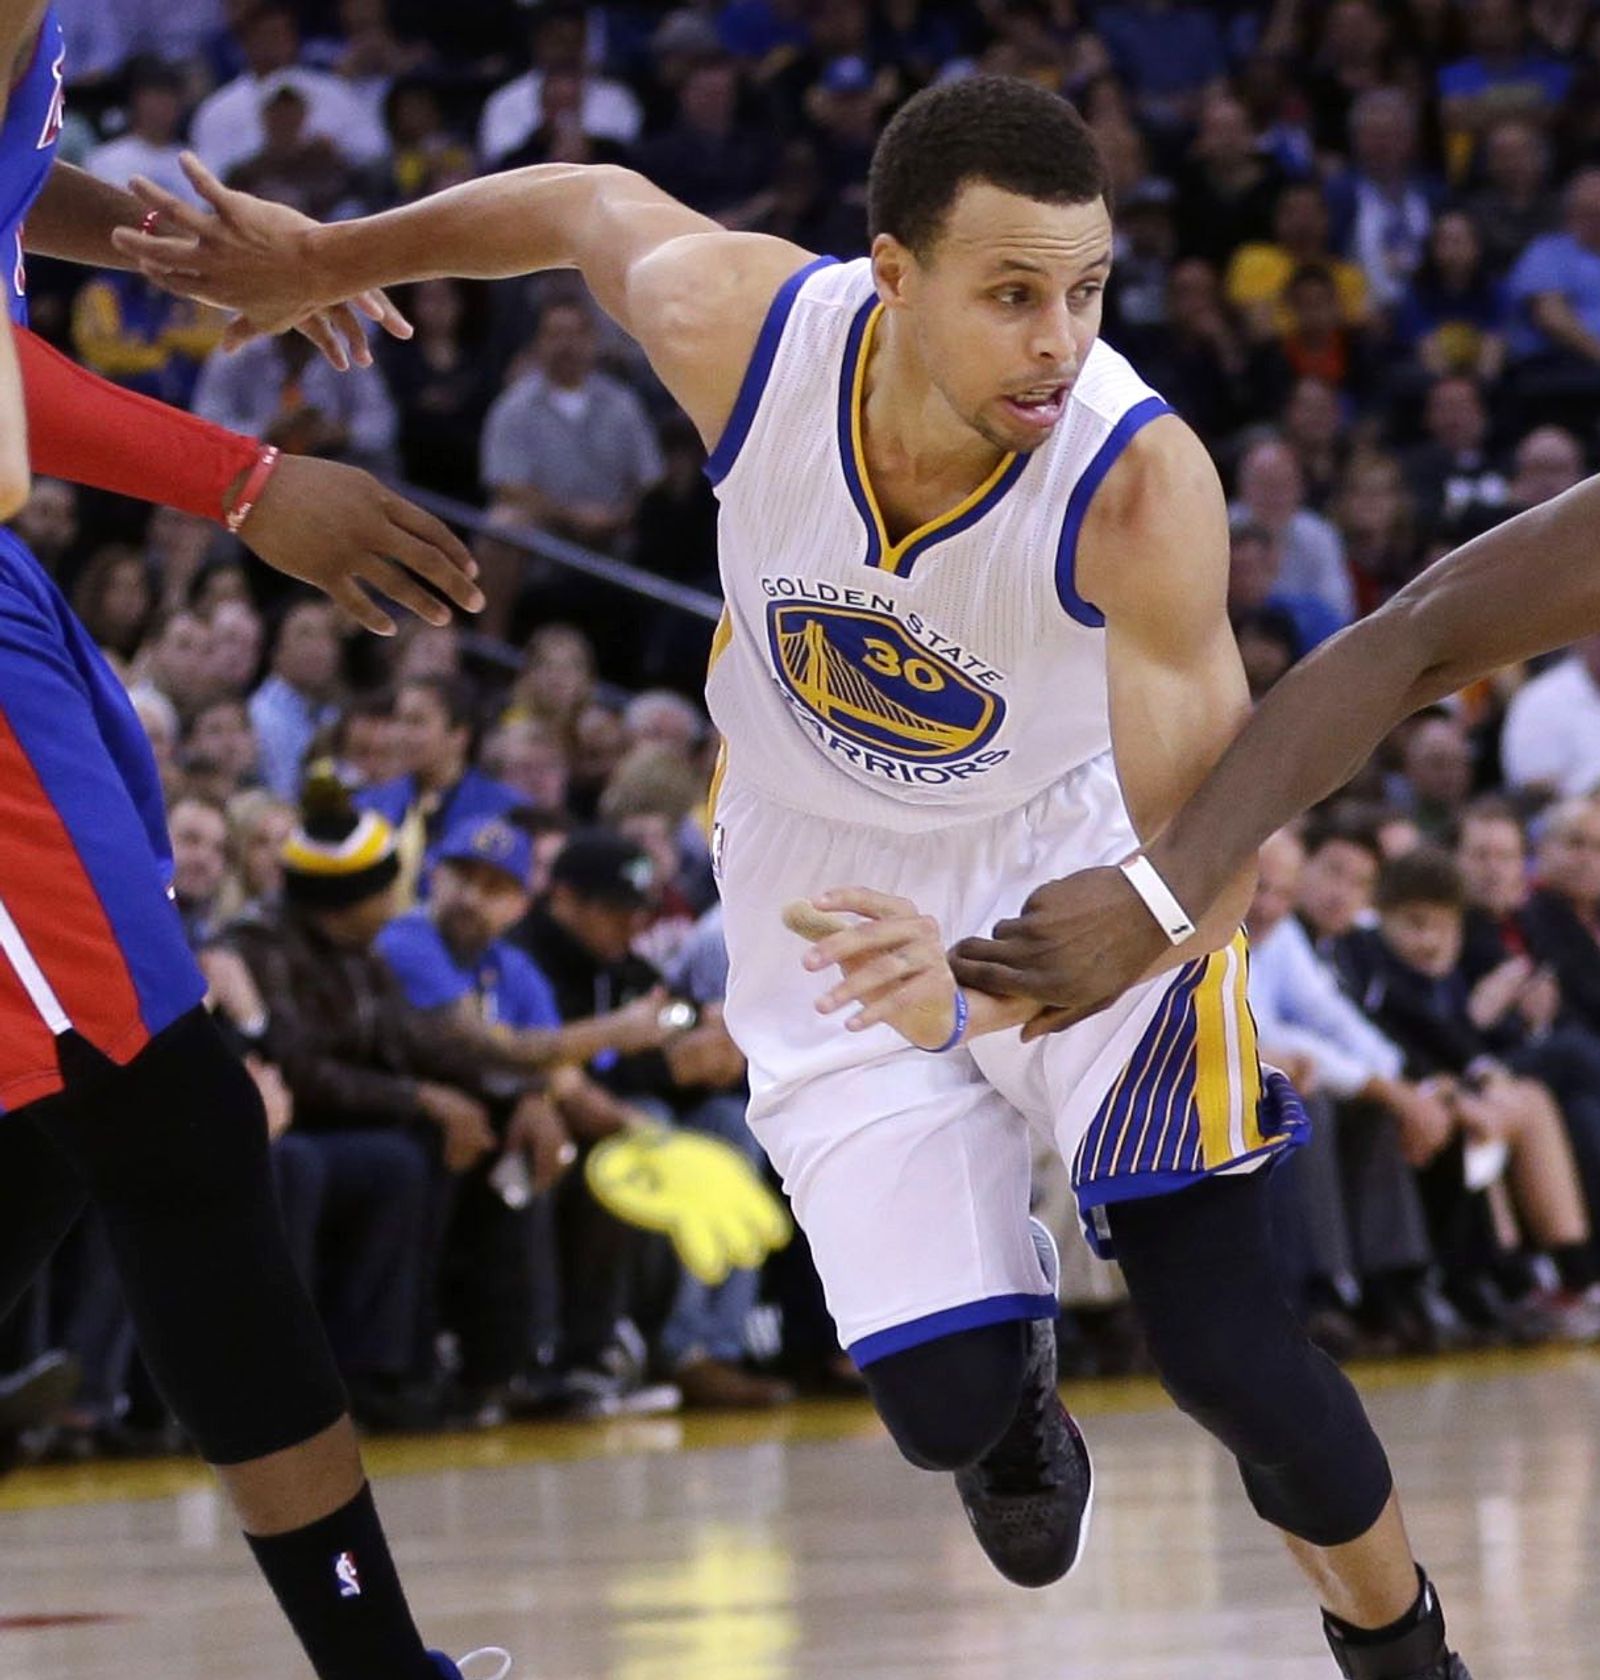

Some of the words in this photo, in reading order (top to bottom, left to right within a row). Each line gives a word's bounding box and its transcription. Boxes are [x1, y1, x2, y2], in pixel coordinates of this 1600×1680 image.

[761, 577, 896, 613] GOLDEN
[906, 613, 1004, 686] STATE
[862, 637, 946, 692] 30
[774, 678, 1011, 785] ARRIORS
